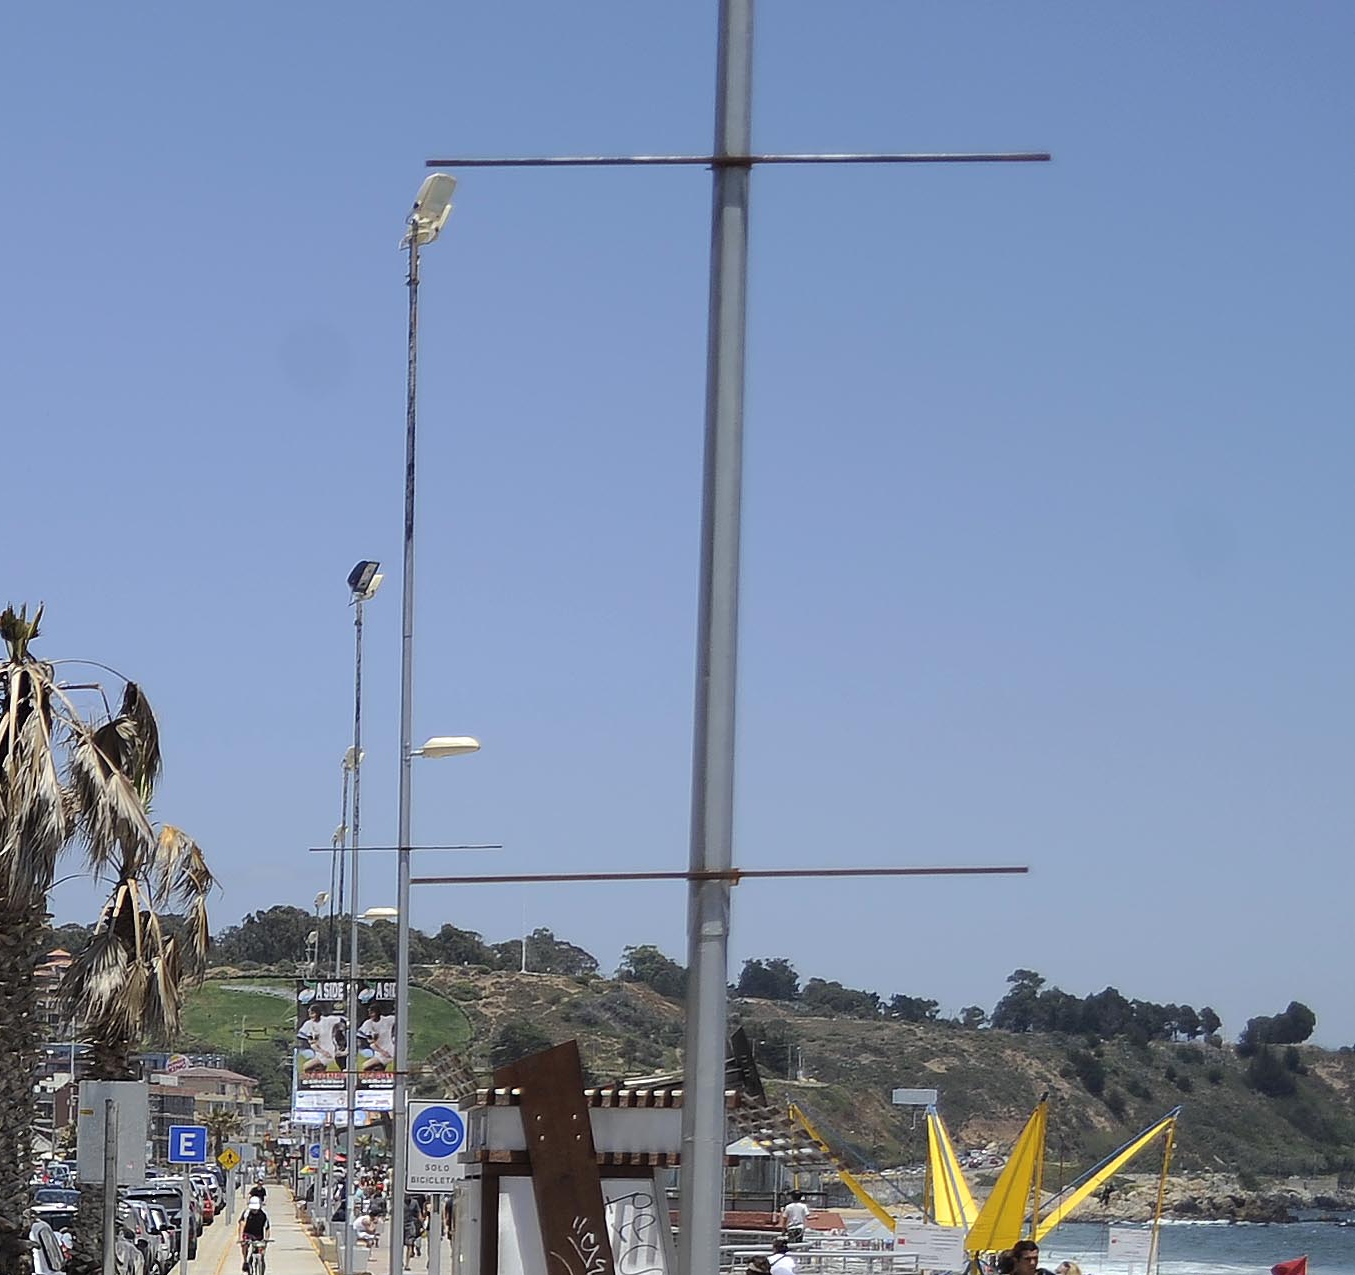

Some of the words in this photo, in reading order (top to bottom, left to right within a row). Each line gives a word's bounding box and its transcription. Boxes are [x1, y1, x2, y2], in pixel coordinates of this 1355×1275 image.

[324, 982, 344, 1000] SIDE
[179, 1132, 196, 1156] E
[424, 1164, 450, 1172] SOLO
[410, 1176, 458, 1184] BICICLETA
